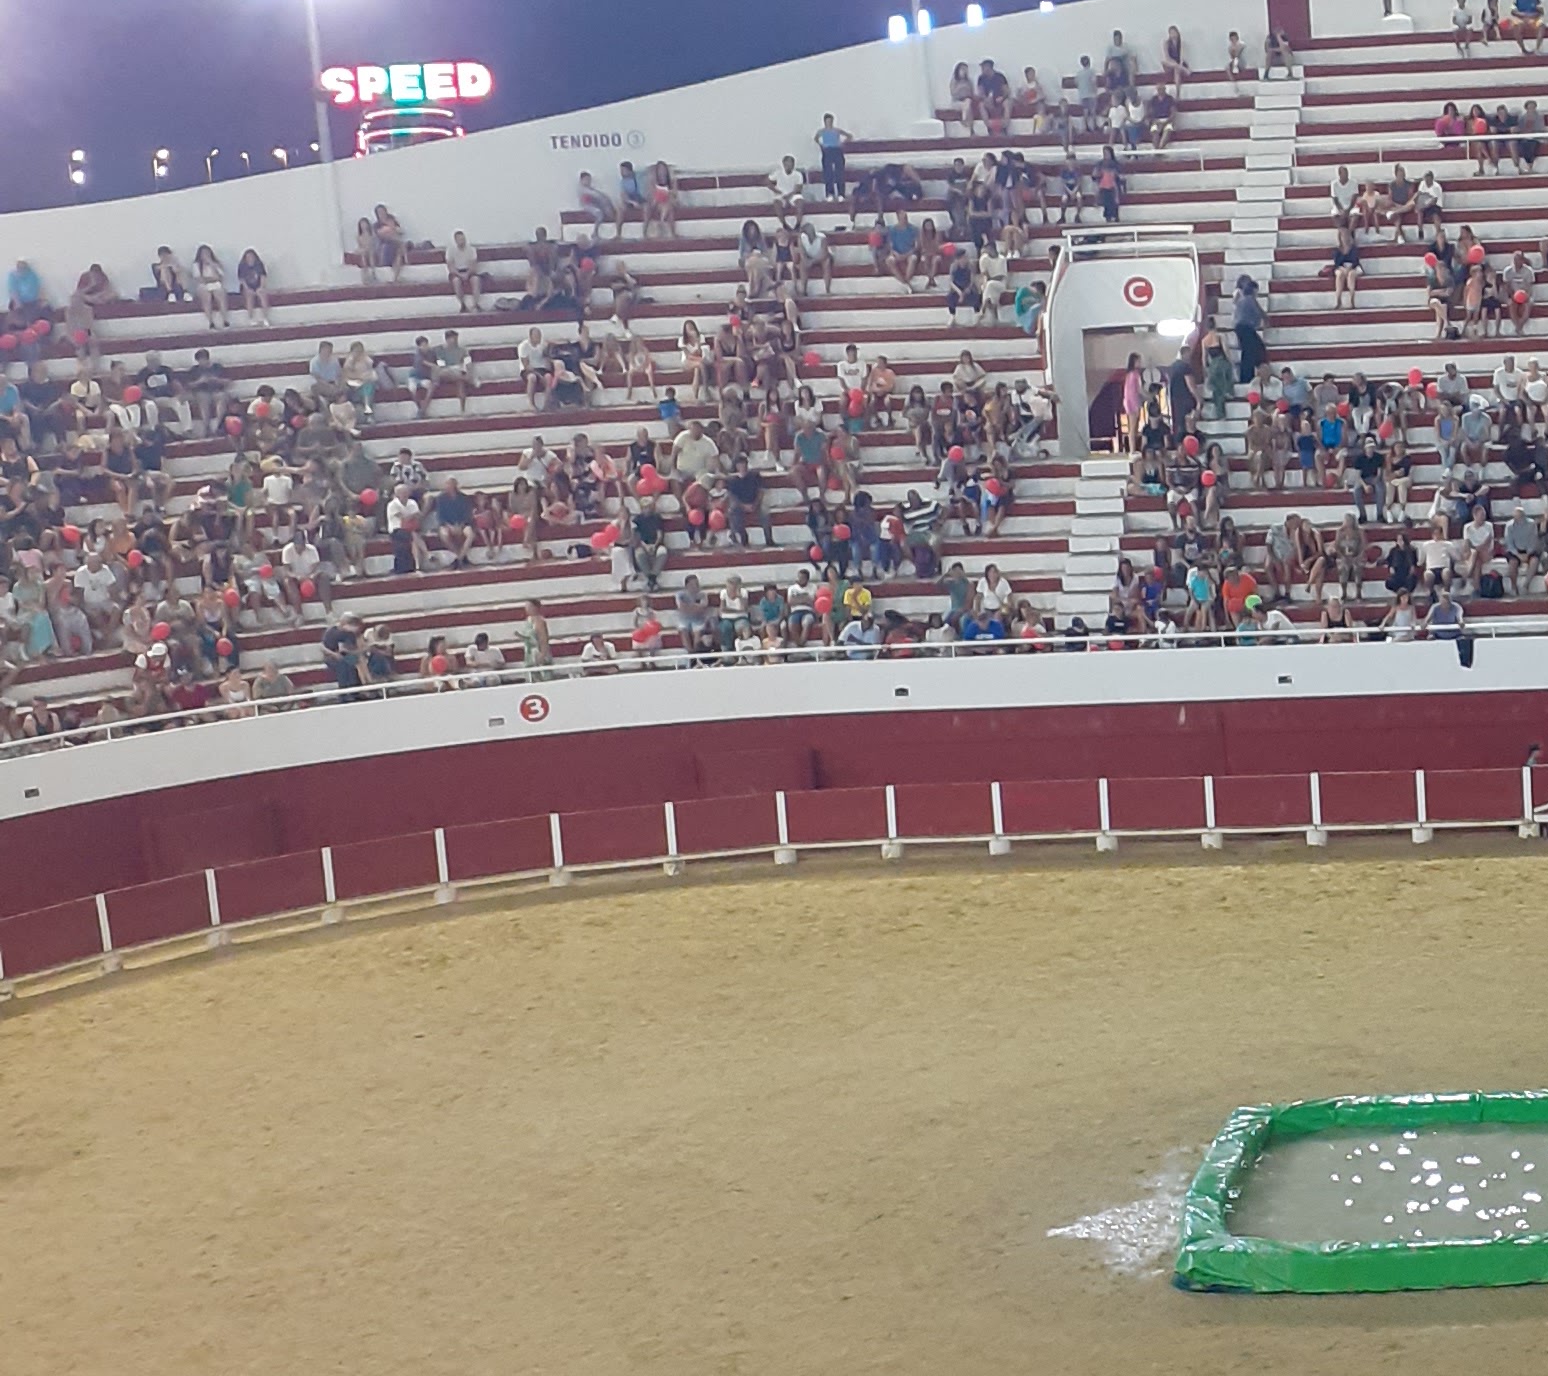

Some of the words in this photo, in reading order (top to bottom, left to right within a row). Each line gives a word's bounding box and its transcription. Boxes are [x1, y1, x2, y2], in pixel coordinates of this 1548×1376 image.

[320, 61, 494, 104] SPEED
[551, 132, 622, 150] TENDIDO
[1127, 280, 1149, 303] C
[525, 697, 546, 719] 3
